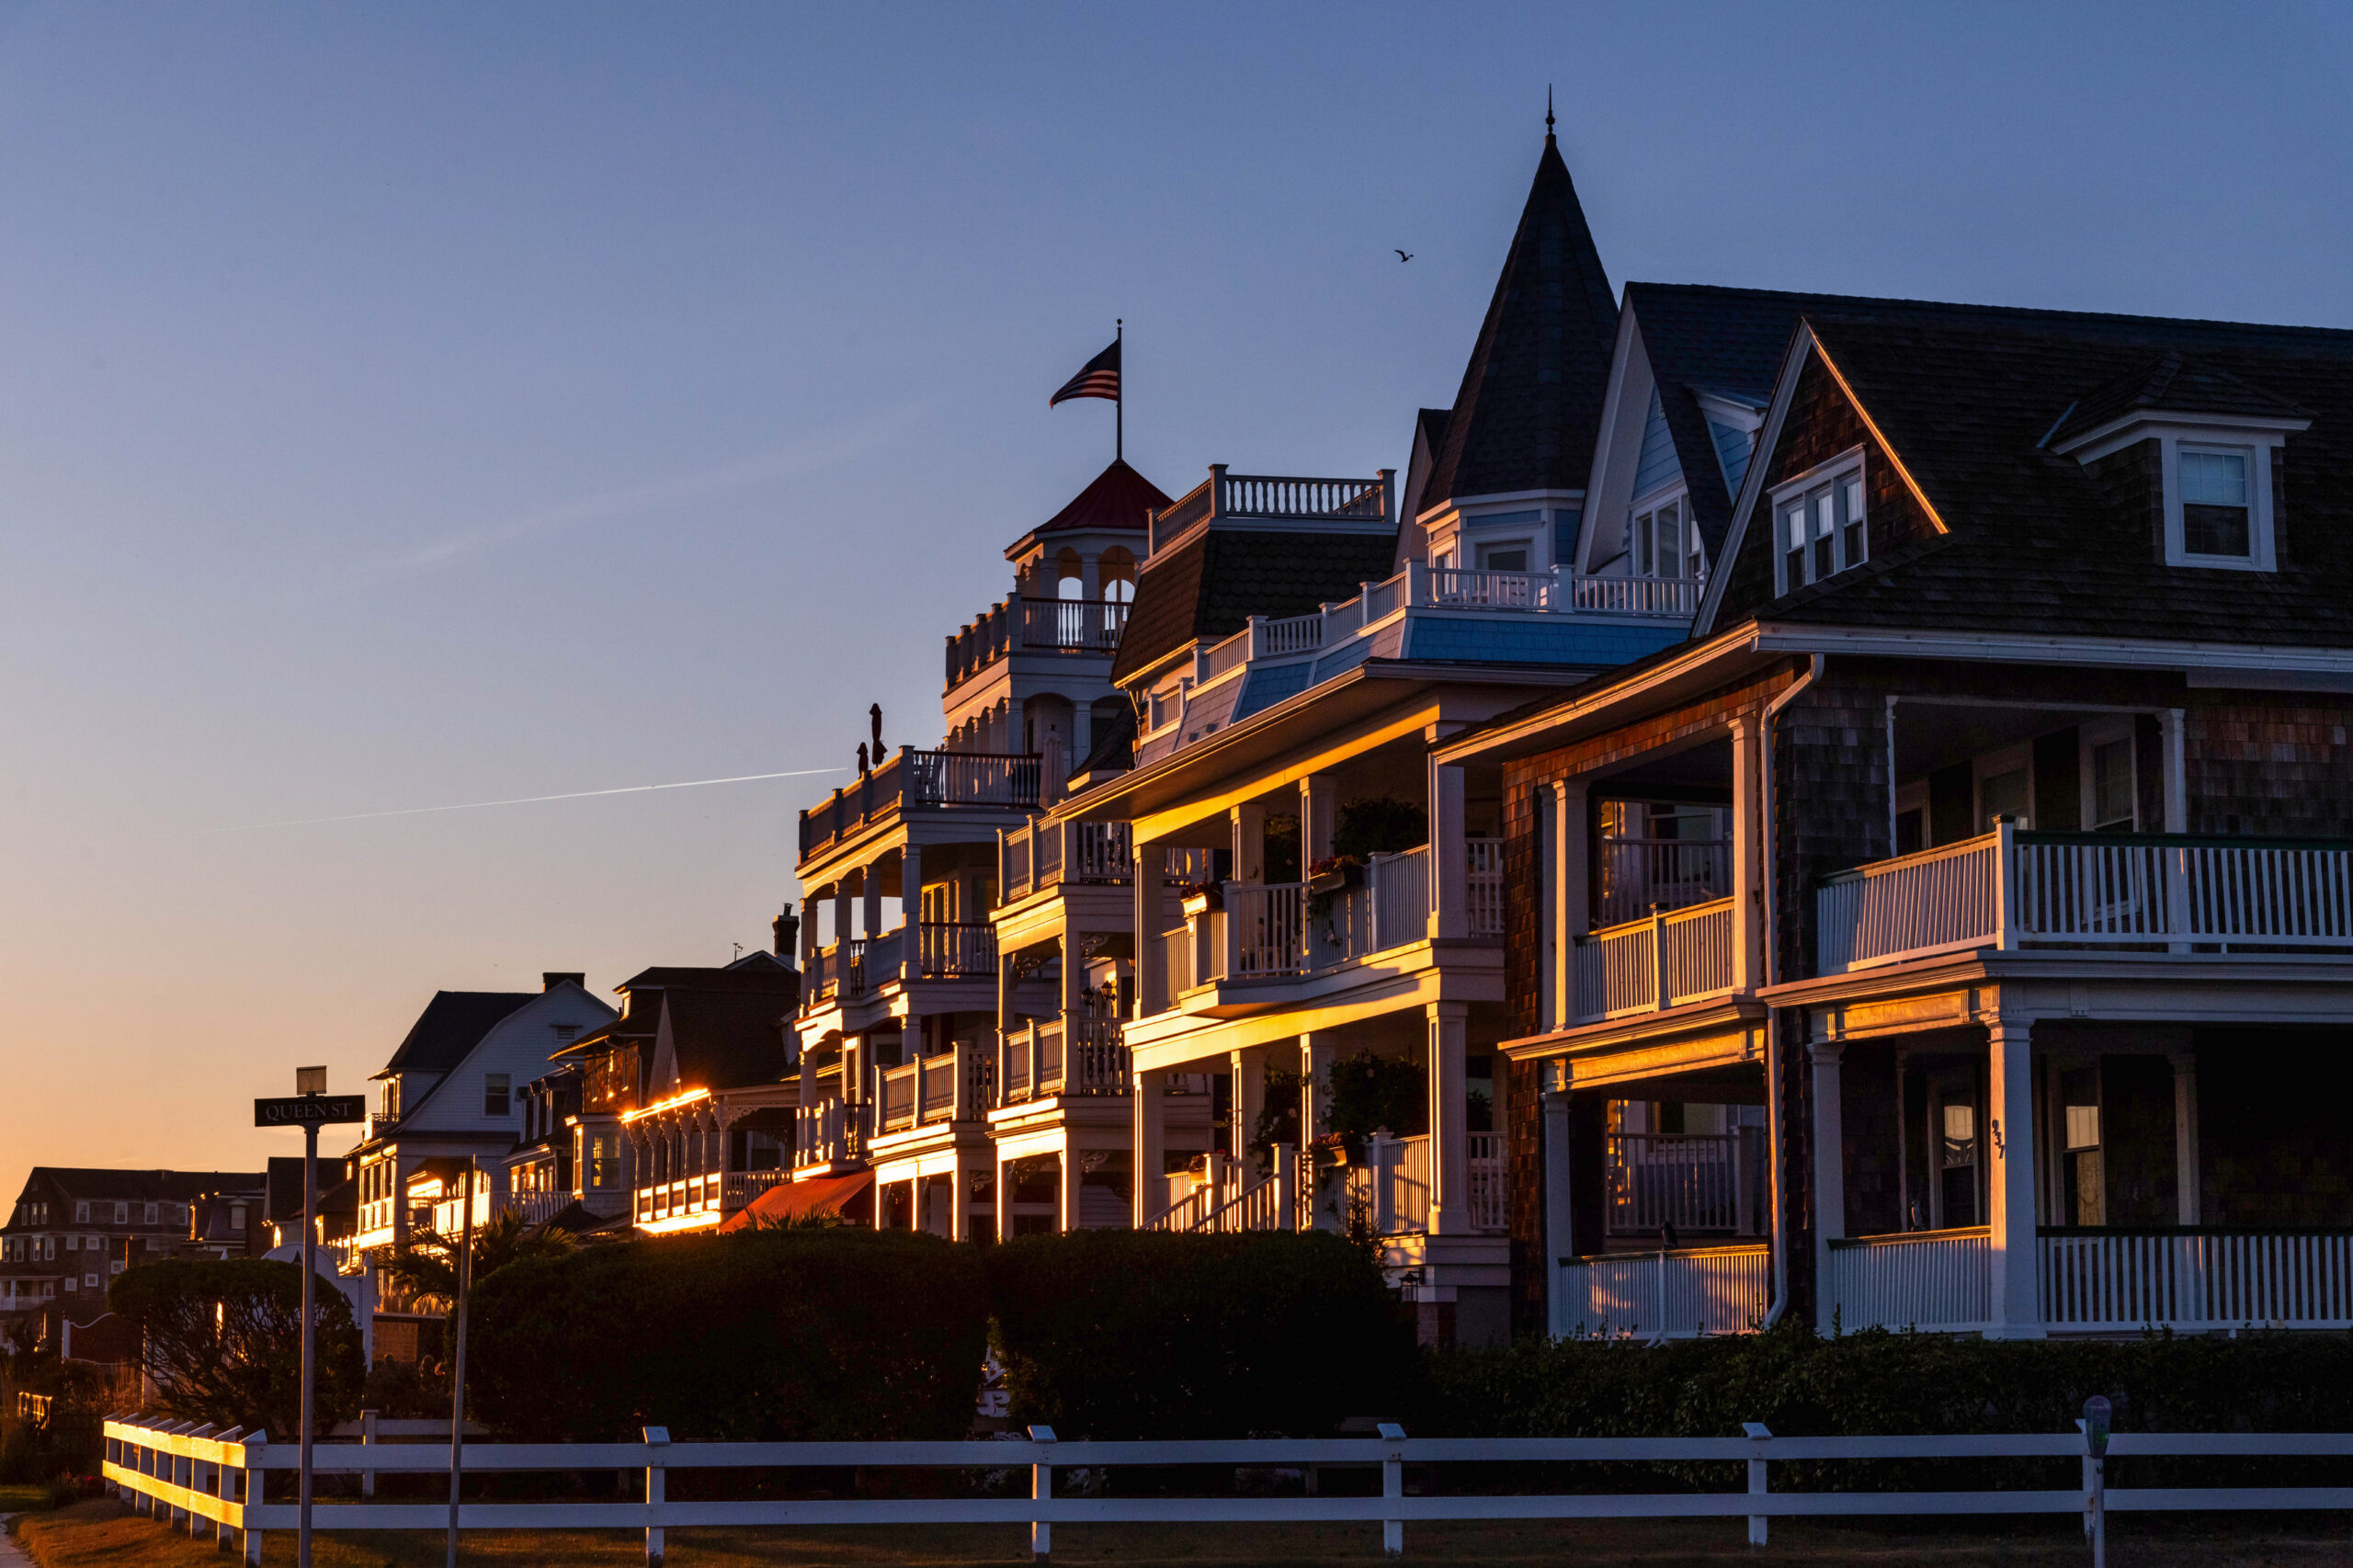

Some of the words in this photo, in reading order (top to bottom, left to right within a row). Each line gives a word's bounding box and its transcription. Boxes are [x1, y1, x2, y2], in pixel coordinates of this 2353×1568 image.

[266, 1104, 326, 1121] QUEEN
[331, 1102, 352, 1117] ST
[1992, 1119, 2006, 1159] 937
